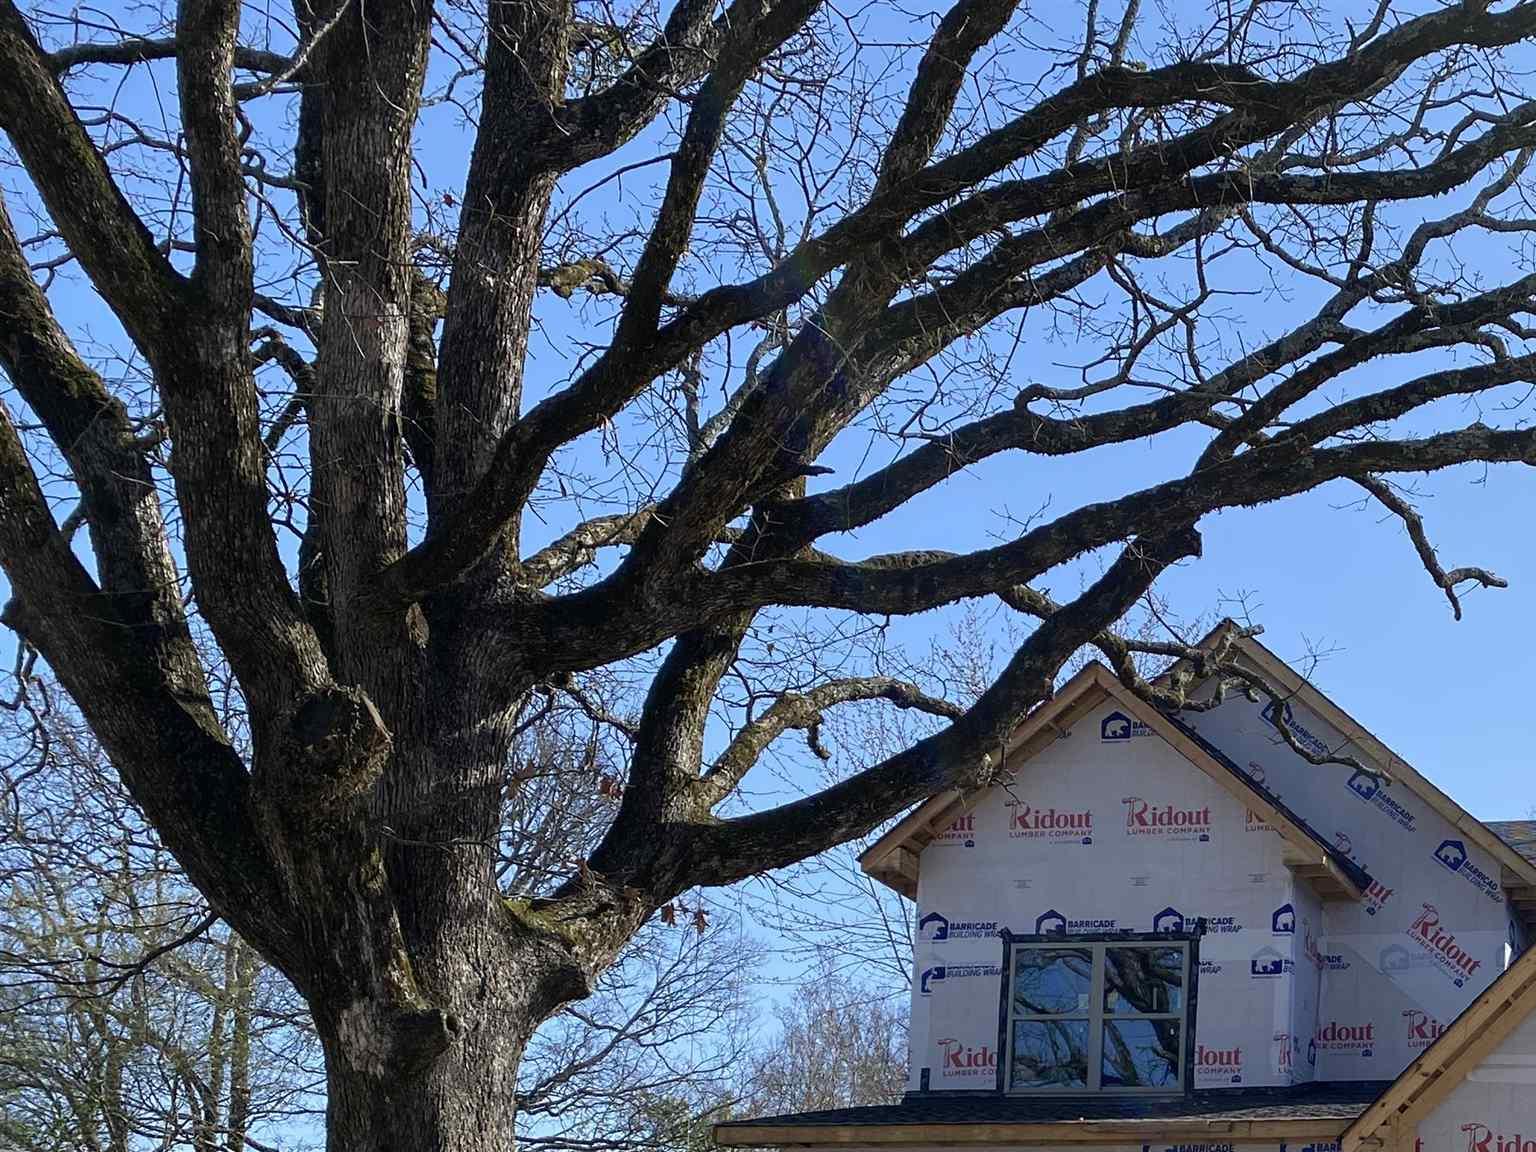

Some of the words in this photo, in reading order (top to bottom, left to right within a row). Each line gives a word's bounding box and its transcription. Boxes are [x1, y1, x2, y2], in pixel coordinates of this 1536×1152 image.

[1005, 799, 1094, 830] Ridout
[1122, 797, 1211, 827] Ridout
[1376, 790, 1415, 822] BARRICADE
[1464, 860, 1498, 891] BARRICAD
[950, 922, 998, 930] BARRICADE
[1068, 920, 1116, 928] BARRICADE
[1411, 901, 1481, 976] Ridout
[937, 1038, 999, 1068] Rido
[1330, 1041, 1375, 1049] COMPANY
[1178, 1144, 1234, 1152] BARRICADE
